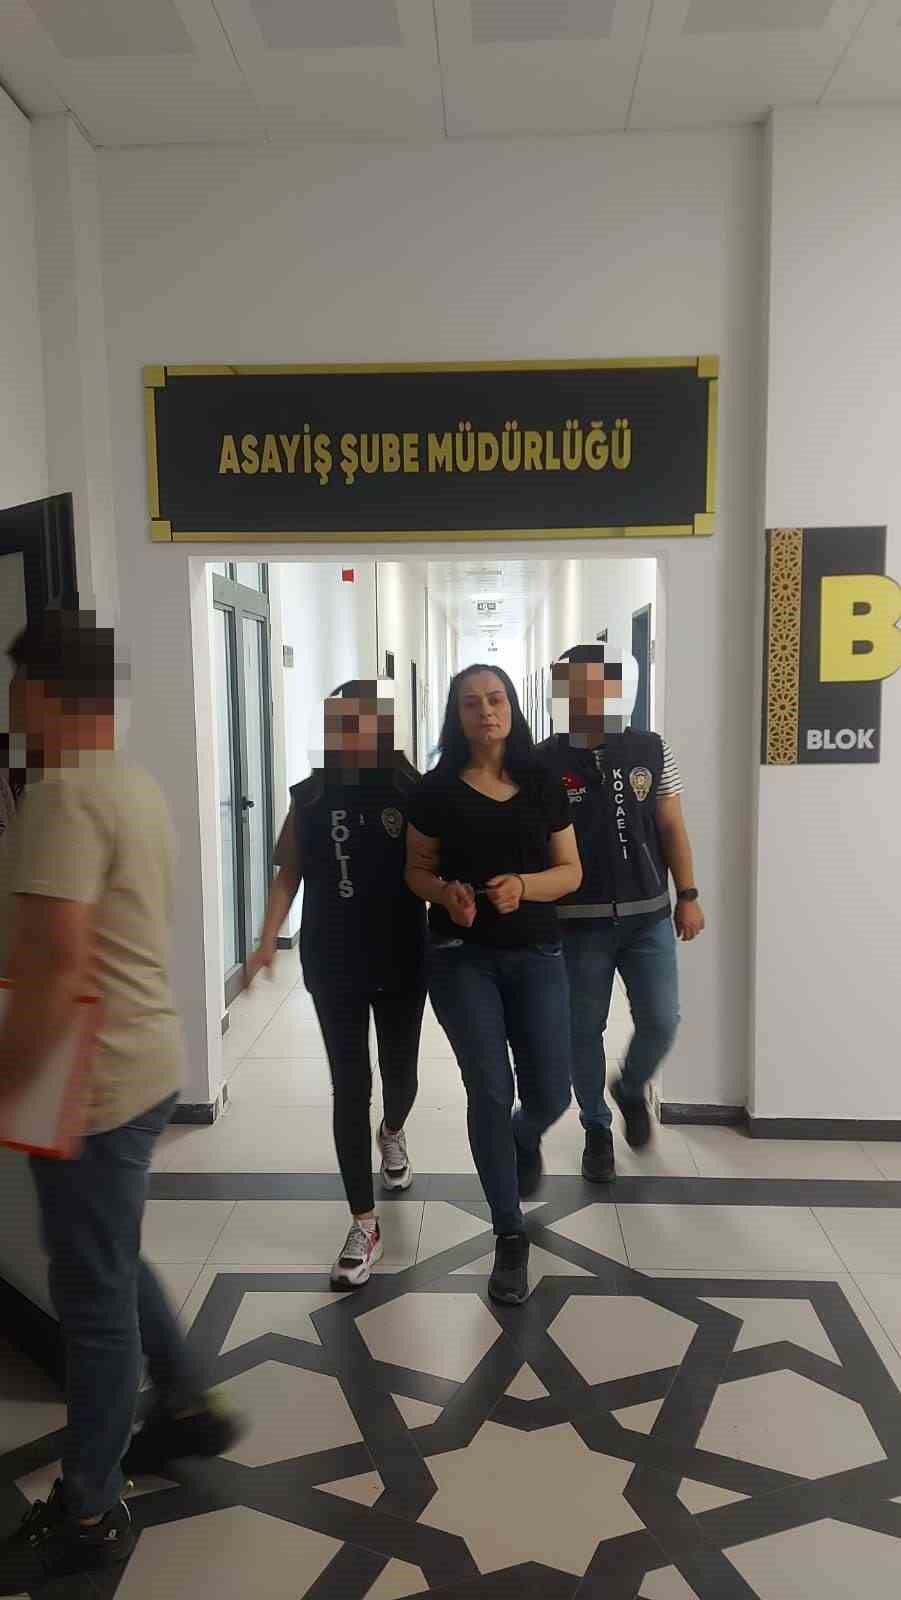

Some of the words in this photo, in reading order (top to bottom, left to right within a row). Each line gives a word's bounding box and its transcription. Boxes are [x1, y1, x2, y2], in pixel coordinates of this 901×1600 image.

[218, 423, 333, 485] ASAYİŞ
[340, 432, 419, 485] ŞUBE
[427, 418, 632, 472] MÜDÜRLÜĞÜ
[819, 574, 901, 682] B
[806, 728, 876, 750] BLOK
